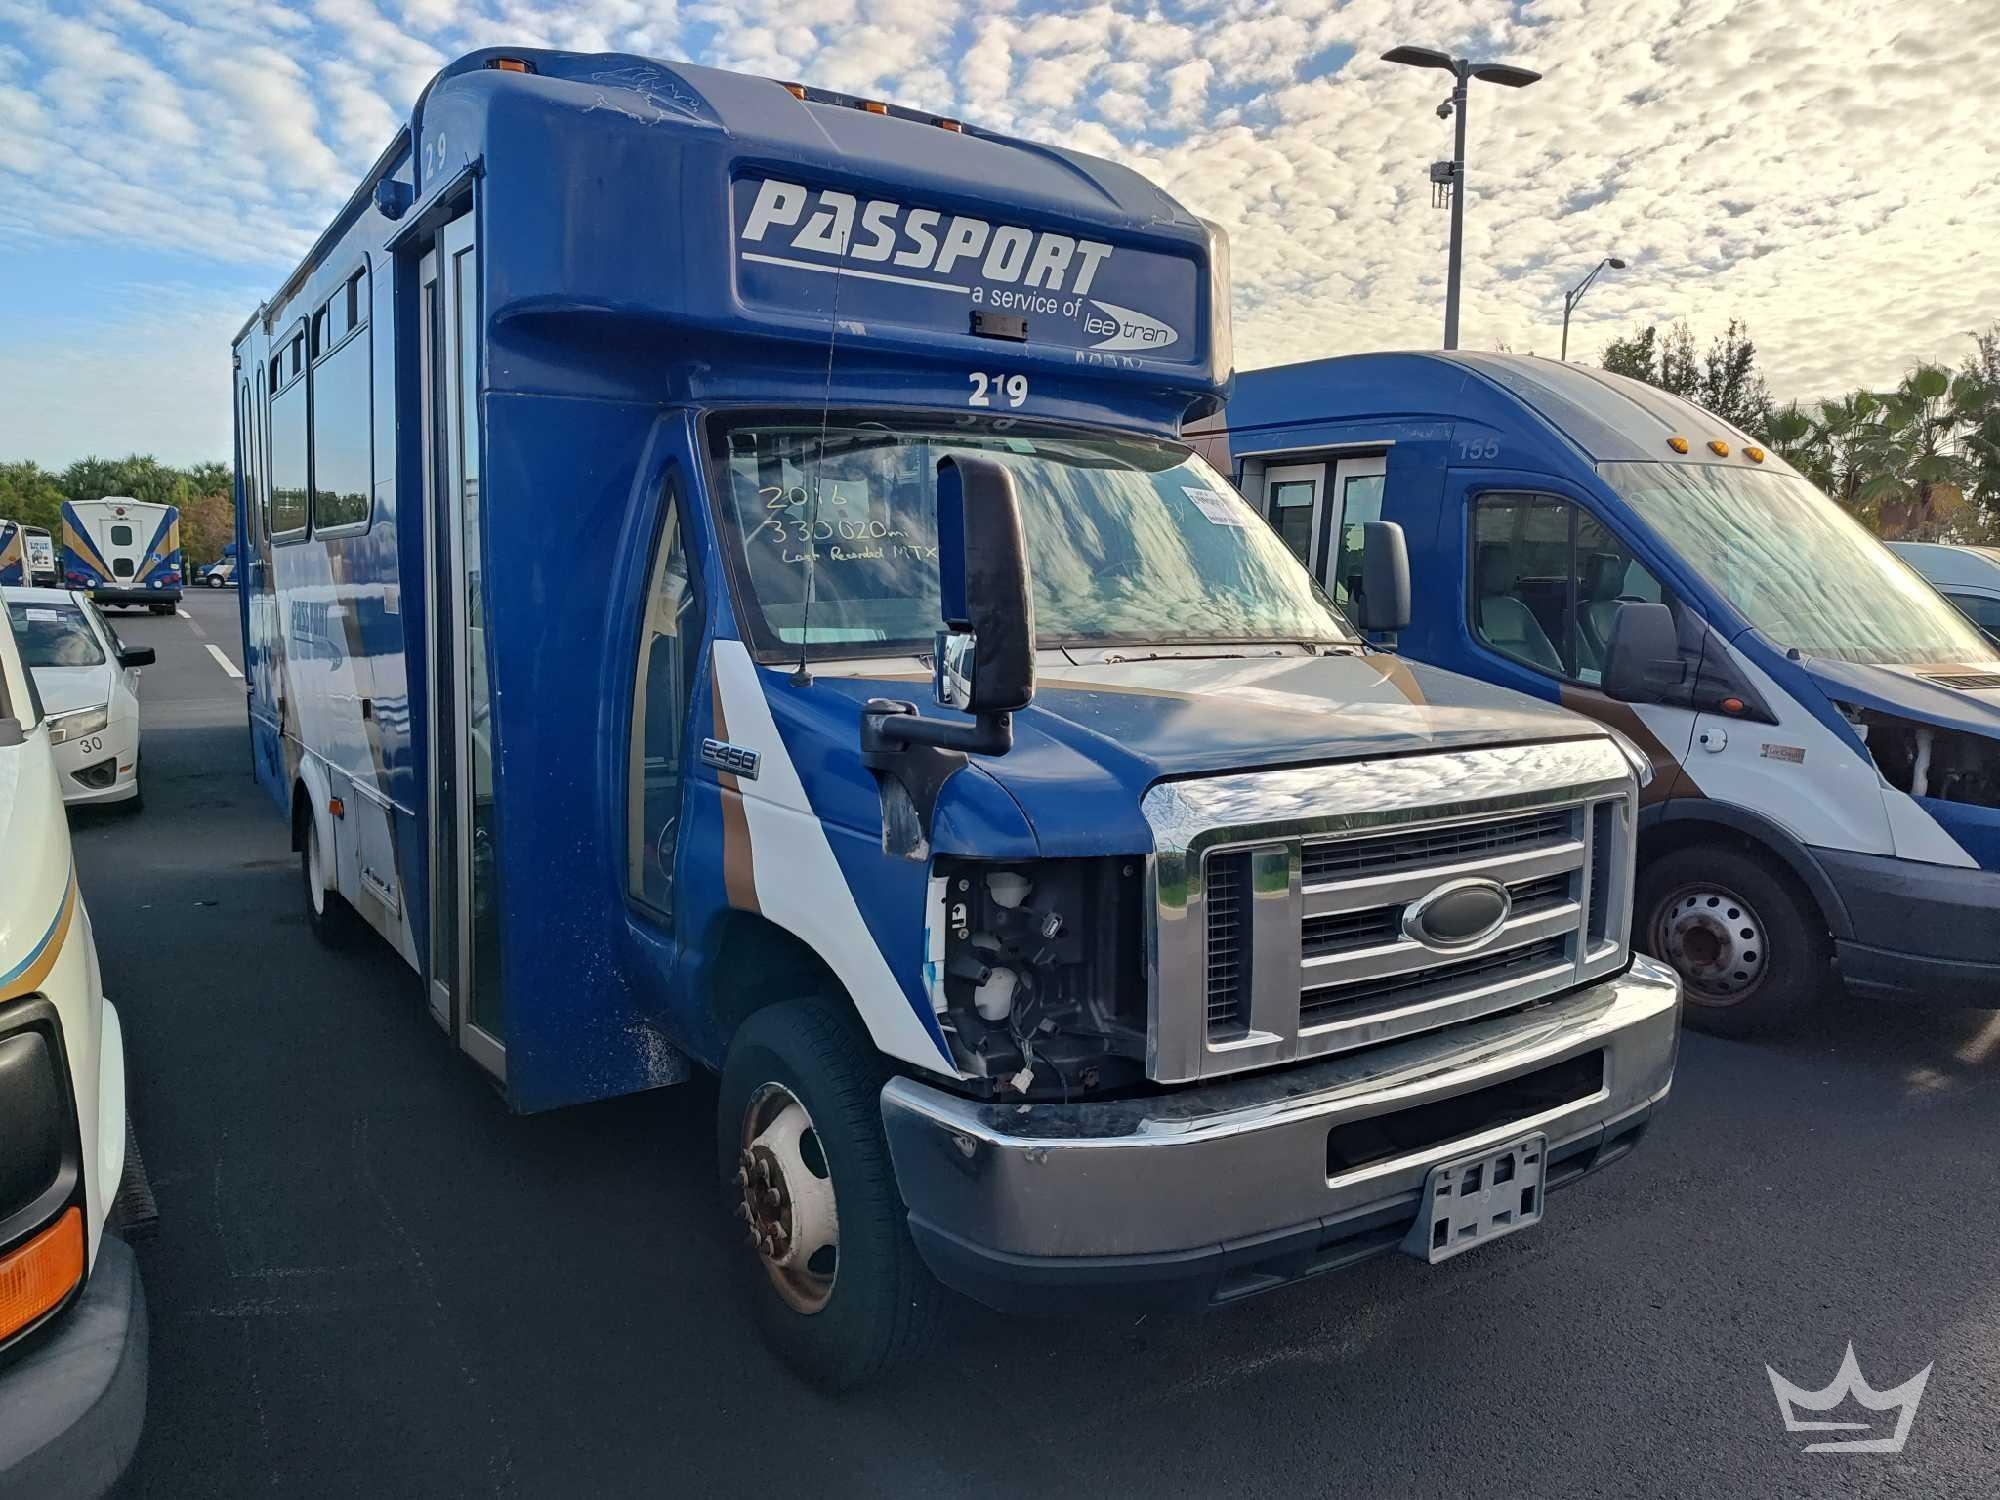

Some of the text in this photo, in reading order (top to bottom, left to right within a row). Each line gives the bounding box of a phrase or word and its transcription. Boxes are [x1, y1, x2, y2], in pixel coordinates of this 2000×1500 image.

[741, 179, 1114, 295] PASSPORT
[971, 286, 1083, 318] a service of
[968, 372, 1029, 408] 219
[758, 484, 848, 509] 2016
[79, 736, 103, 754] 30
